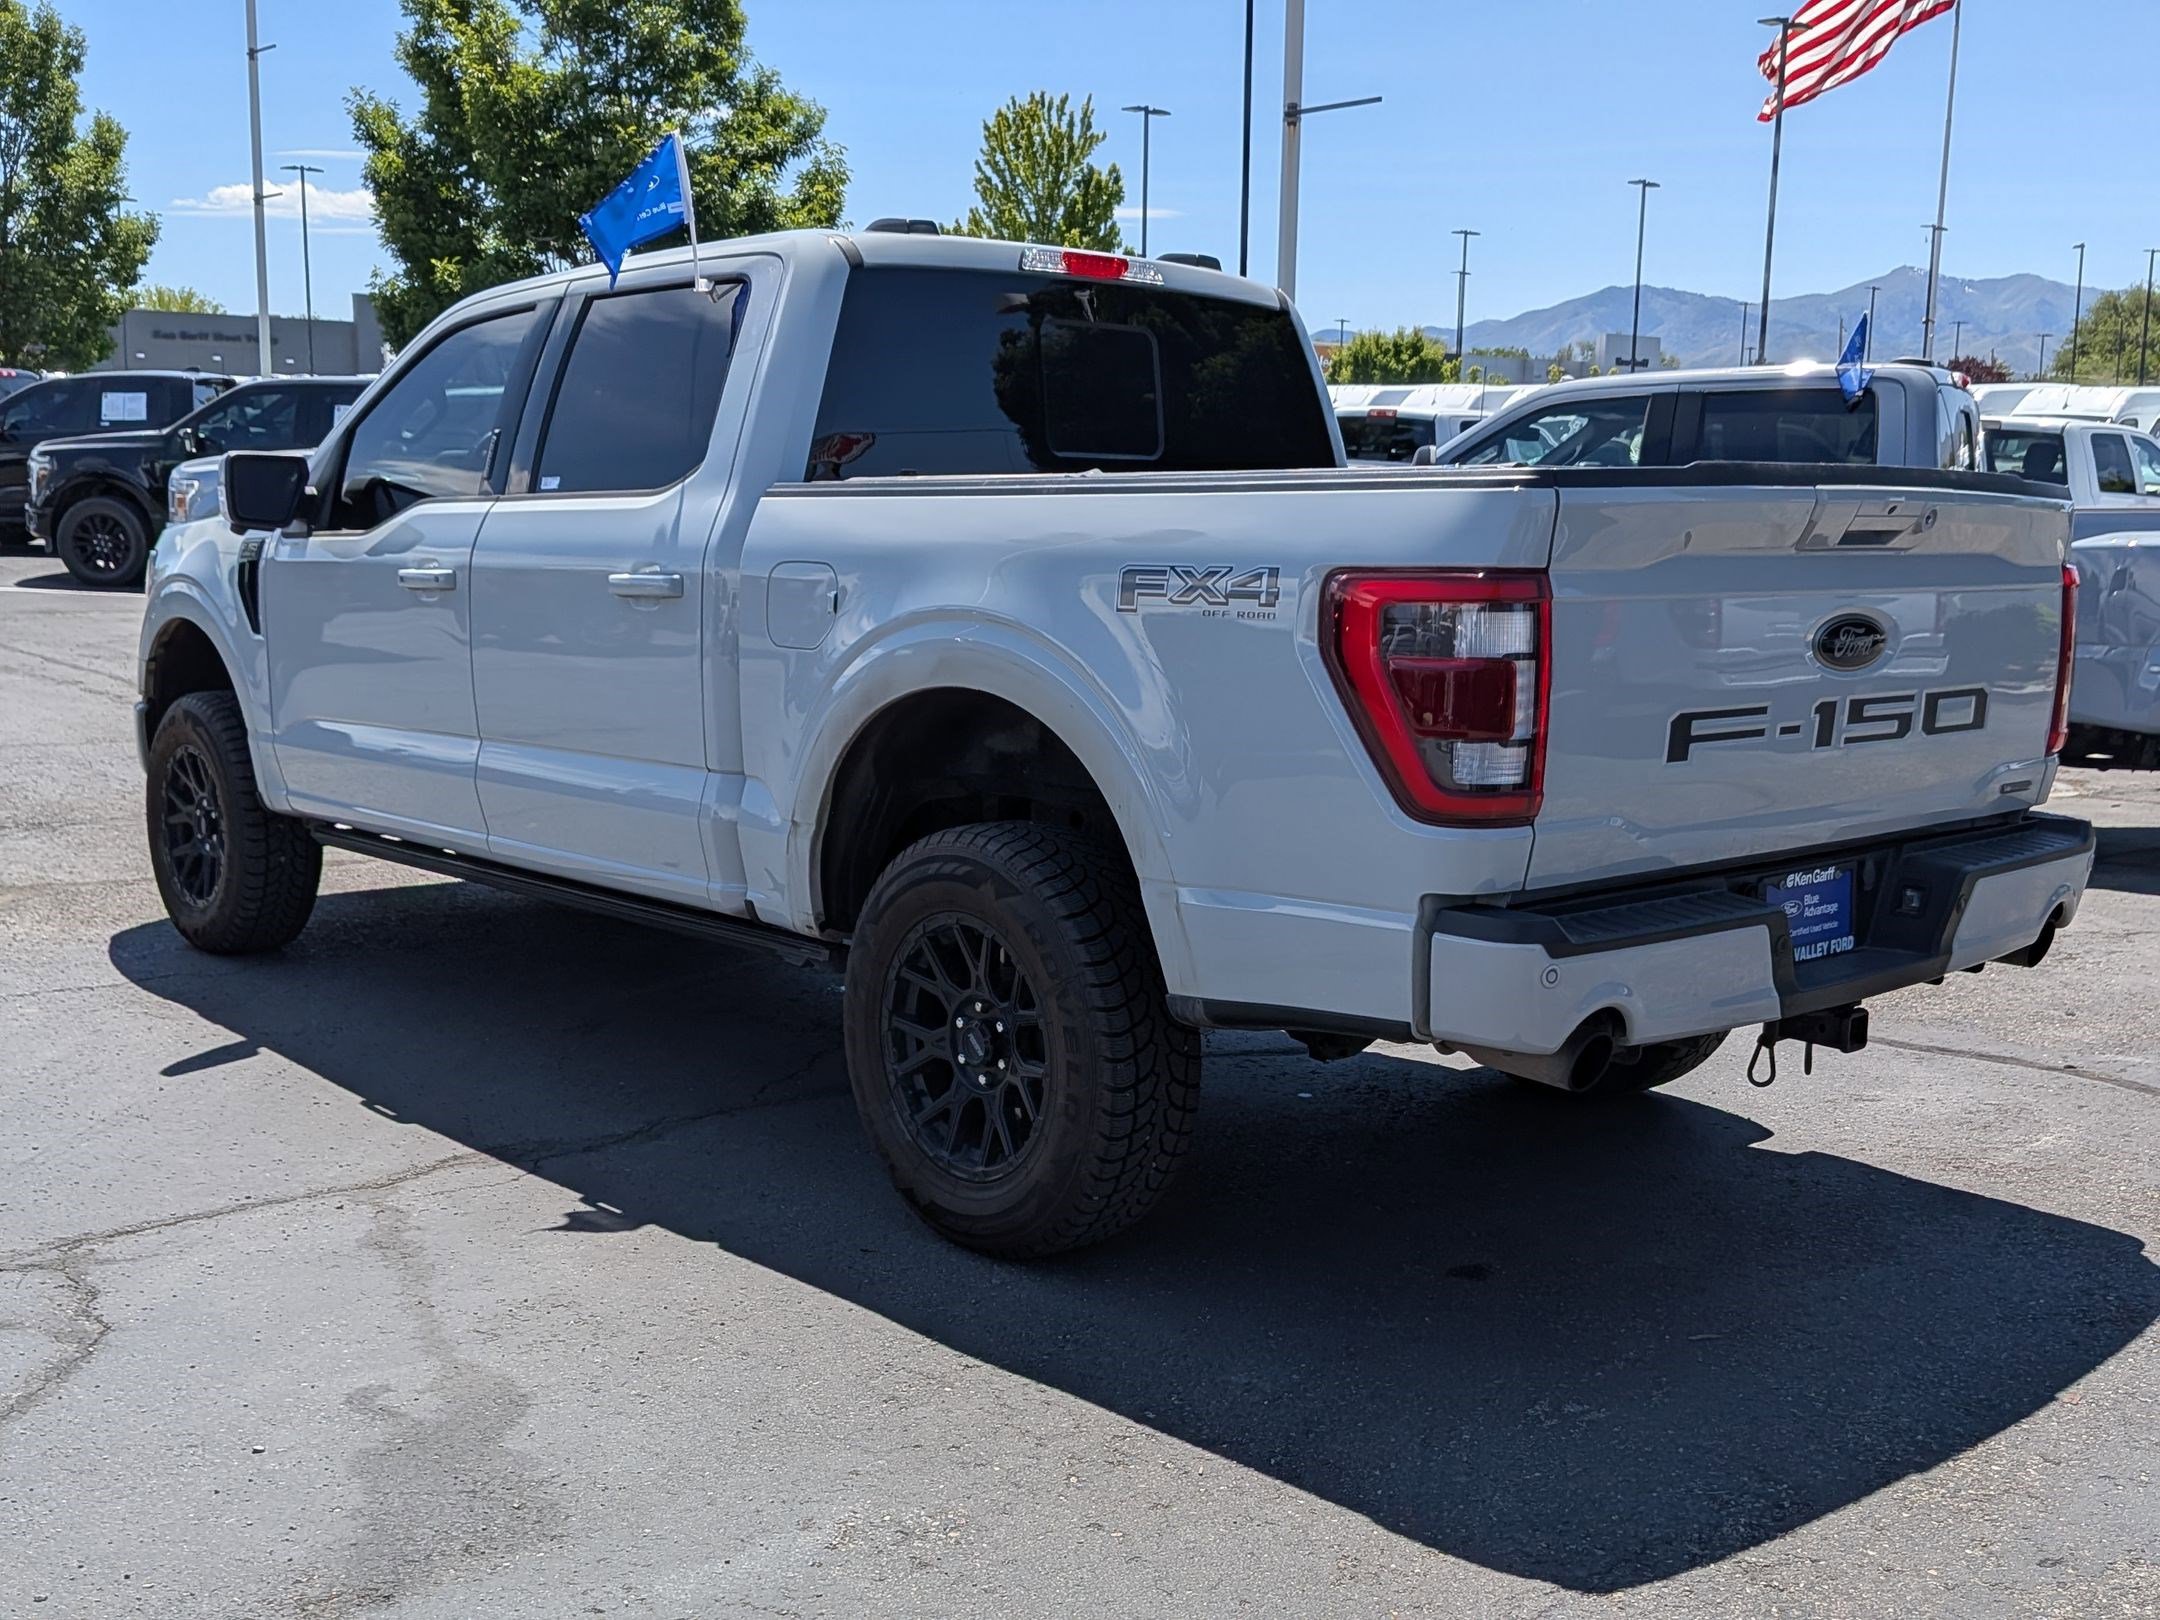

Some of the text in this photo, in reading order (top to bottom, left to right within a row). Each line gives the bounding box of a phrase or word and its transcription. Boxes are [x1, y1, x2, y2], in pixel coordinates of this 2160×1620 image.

[1116, 564, 1281, 614] FX4
[1202, 609, 1277, 620] OFF ROAD
[1665, 685, 1990, 764] F-150
[1803, 902, 1839, 918] Advantage
[1804, 894, 1820, 906] Blue
[1793, 935, 1855, 962] VALLEY FORD
